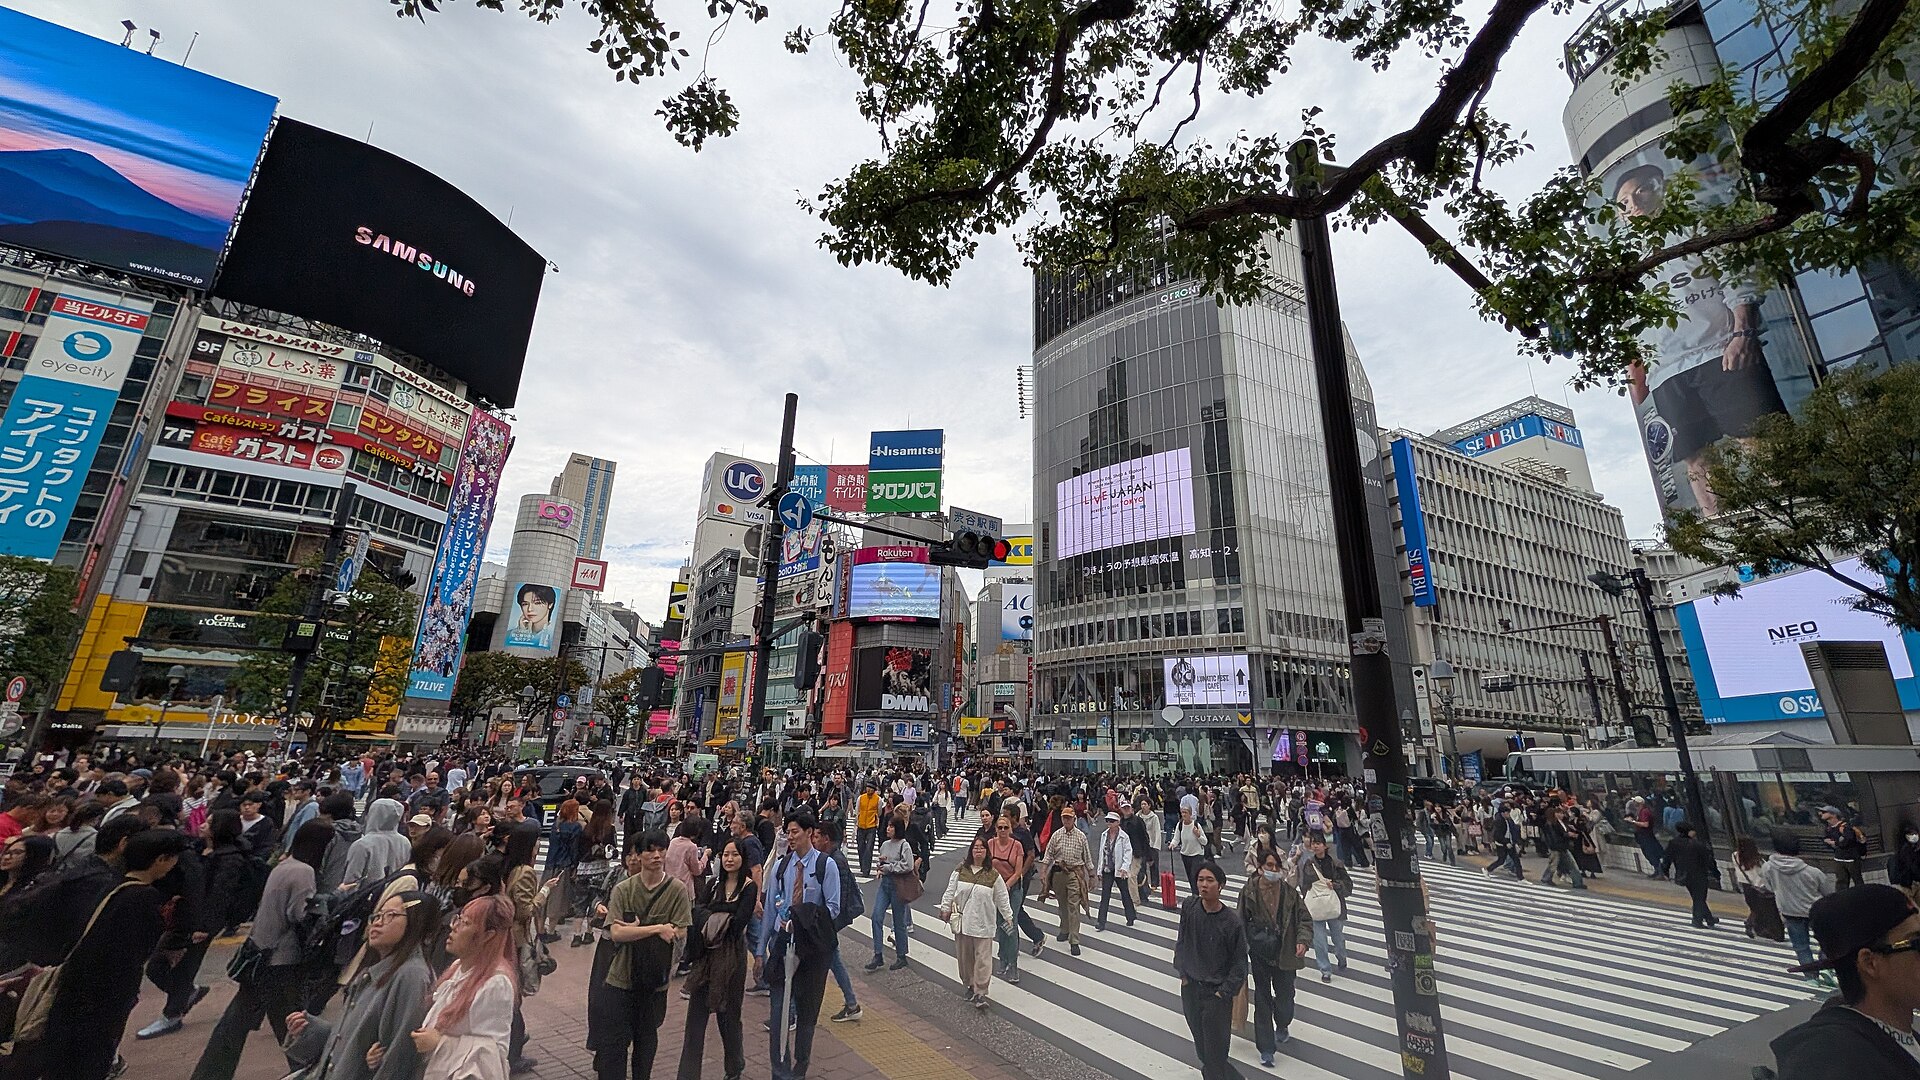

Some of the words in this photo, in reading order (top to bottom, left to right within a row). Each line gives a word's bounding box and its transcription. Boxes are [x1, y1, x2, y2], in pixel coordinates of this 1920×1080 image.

[354, 225, 475, 297] SAMSUNG
[129, 260, 204, 284] www.hit-ad.co.jp
[63, 300, 140, 325] 当ビル5F
[197, 340, 222, 354] 9F
[42, 359, 116, 382] eyecity
[267, 352, 337, 379] しゃぶ葉
[214, 383, 327, 417] プライス
[417, 398, 464, 430] しゃぶ葉
[164, 426, 194, 442] 7F
[203, 411, 276, 432] Caféレストラン
[276, 422, 333, 444] ガスト
[360, 411, 438, 455] コンタクト
[1542, 421, 1580, 446] SEIBU
[200, 432, 233, 446] Café
[1465, 422, 1525, 457] SEIBU
[233, 437, 306, 464] ガスト
[319, 456, 342, 465] ガスト
[871, 445, 941, 457] Hisamitsu
[25, 406, 97, 528] コンタクトの
[412, 461, 447, 484] ガスト
[872, 482, 936, 500] サロンパス
[1363, 476, 1382, 488] TAYA
[1084, 491, 1107, 505] LIVE
[1110, 481, 1152, 499] JAPAN
[538, 500, 574, 529] 109
[745, 510, 764, 521] VISA
[954, 511, 998, 531] 渋谷駅前
[877, 548, 914, 559] Rakuten
[1008, 545, 1032, 556] KE
[580, 568, 598, 580] H&M
[817, 535, 836, 604] もんじゃ
[1408, 548, 1428, 598] SEIBU
[199, 617, 247, 629] L'OCCITANE
[1767, 620, 1818, 640] NEO
[415, 680, 445, 692] 17LIVE
[881, 694, 928, 712] DMM
[1053, 700, 1140, 714] STARBUKS
[855, 721, 923, 737] 大盛書店
